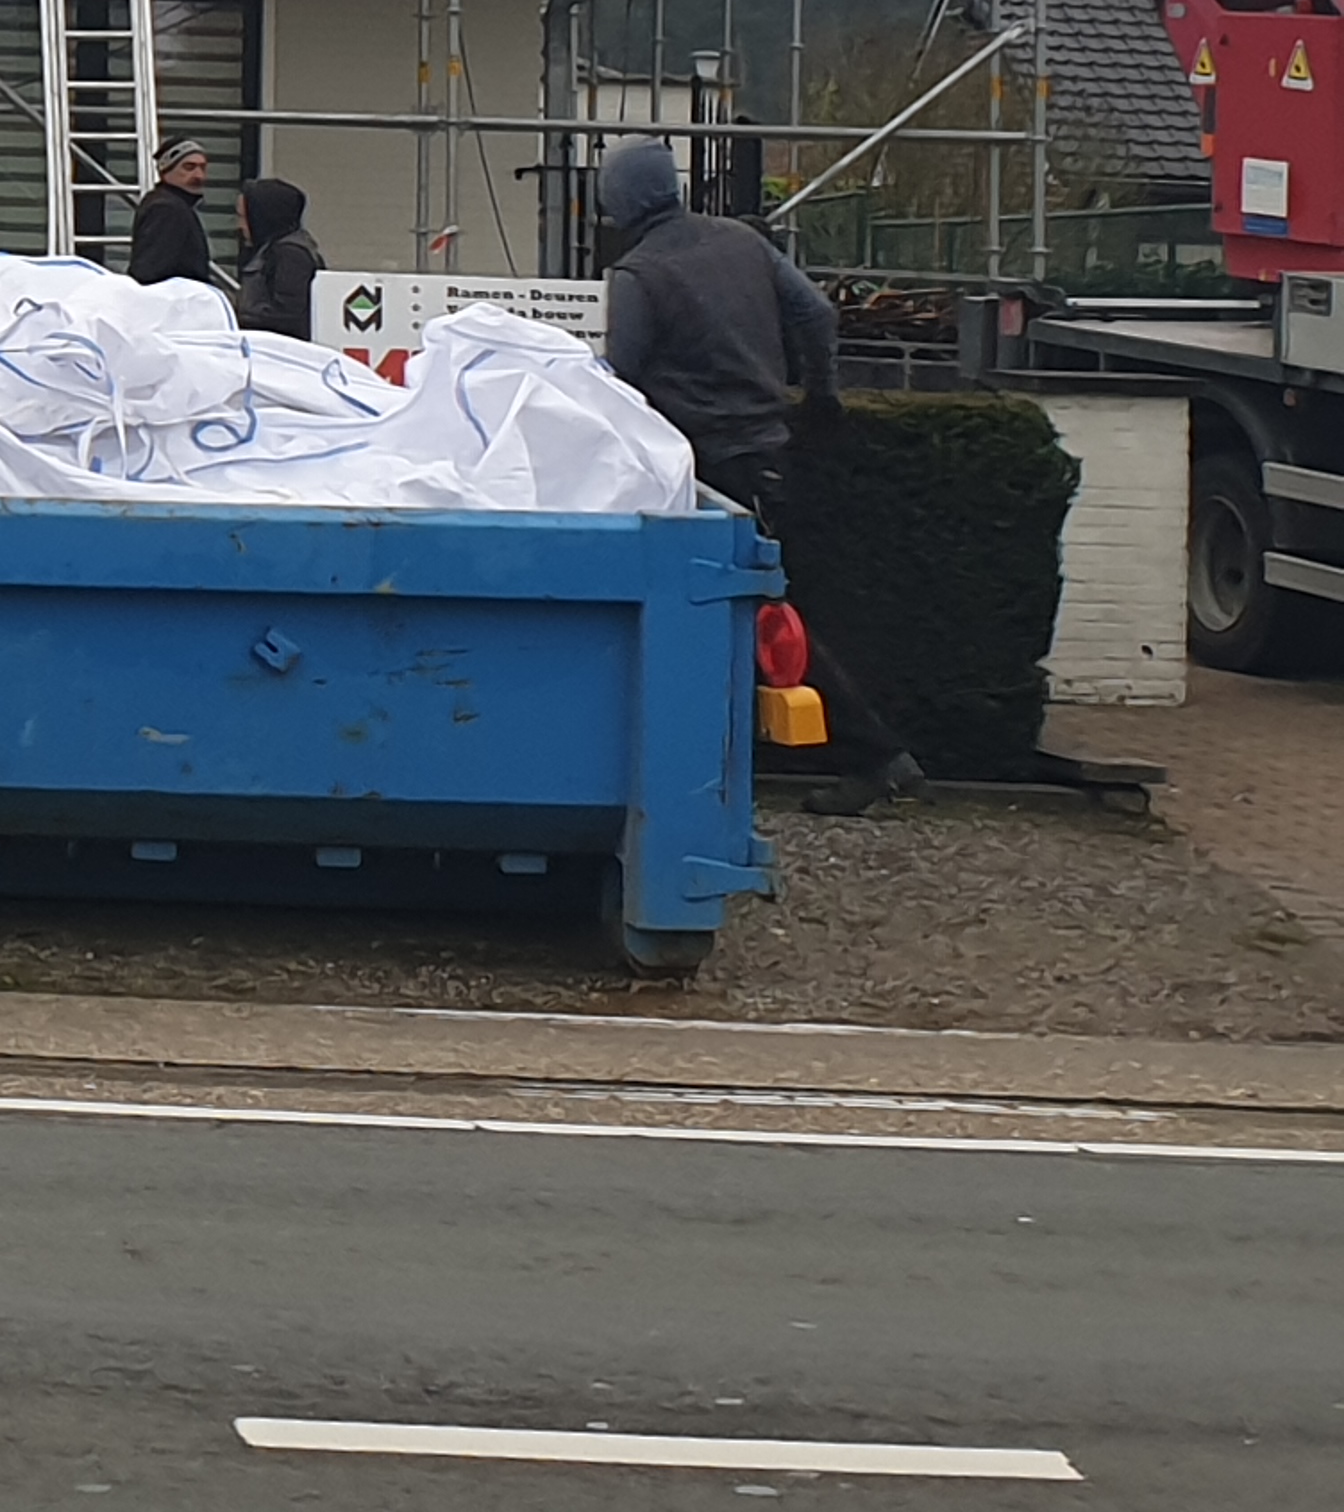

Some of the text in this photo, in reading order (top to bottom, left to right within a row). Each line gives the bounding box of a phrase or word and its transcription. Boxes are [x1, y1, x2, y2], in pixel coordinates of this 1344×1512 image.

[447, 286, 514, 299] Ramen
[530, 289, 599, 303] Deuren
[532, 307, 584, 321] bouw
